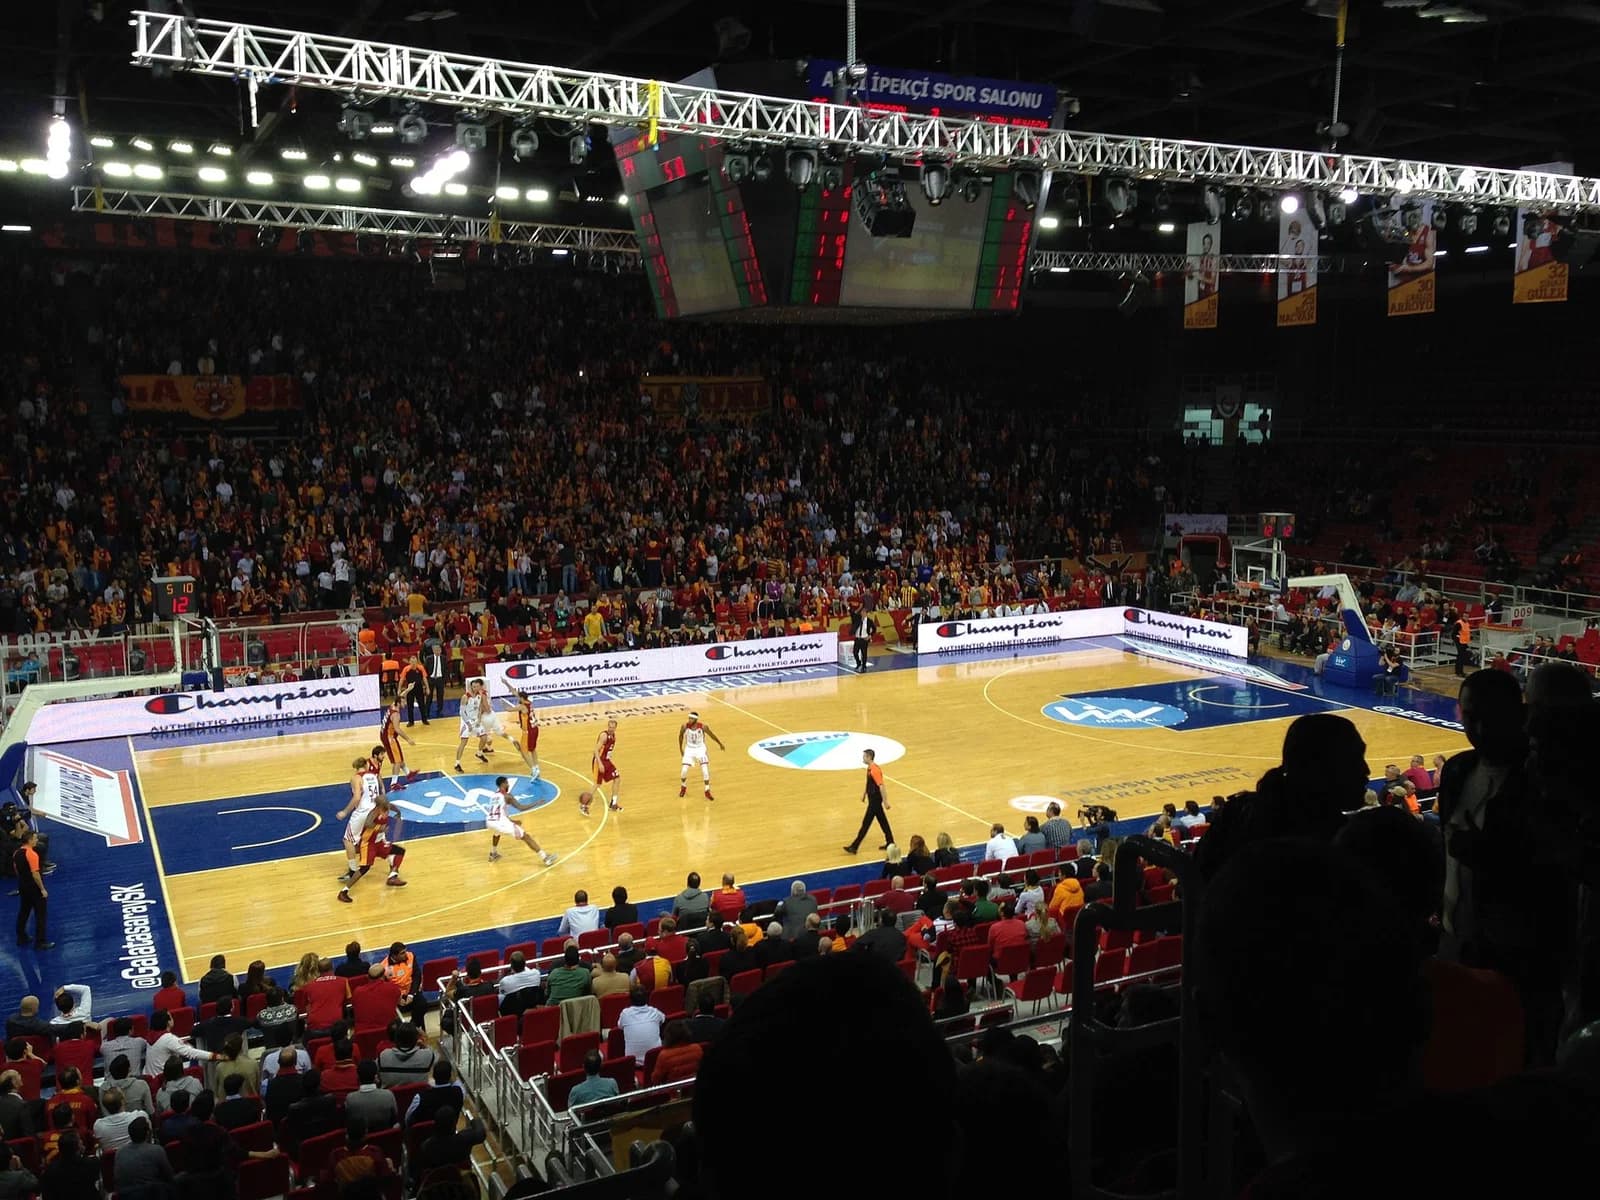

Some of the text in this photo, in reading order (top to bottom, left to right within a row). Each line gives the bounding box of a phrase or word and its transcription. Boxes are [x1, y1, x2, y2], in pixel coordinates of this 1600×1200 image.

[871, 73, 930, 101] İPEKÇİ
[932, 82, 976, 103] SPOR
[978, 88, 1043, 110] SALONU
[171, 595, 190, 614] 12
[1513, 606, 1532, 618] 009
[937, 616, 1063, 638] Champion
[1123, 608, 1233, 640] Champion
[705, 640, 824, 664] Champion
[505, 658, 640, 681] Champion
[707, 656, 822, 673] AUTHENTIC ATHLETIC APPAREL
[559, 679, 600, 688] ATHLETIC
[601, 675, 640, 684] APPAREL
[144, 683, 354, 714] Champion
[604, 703, 686, 716] AIRLINES
[151, 704, 354, 733] AUTHENTIC ATHLETIC APPAREL
[758, 732, 851, 748] DAIKIN
[1060, 765, 1242, 797] TURKISH AIRLINES
[1076, 771, 1256, 804] EUROLEAGUE
[110, 882, 162, 990] @GalatasaraySK
